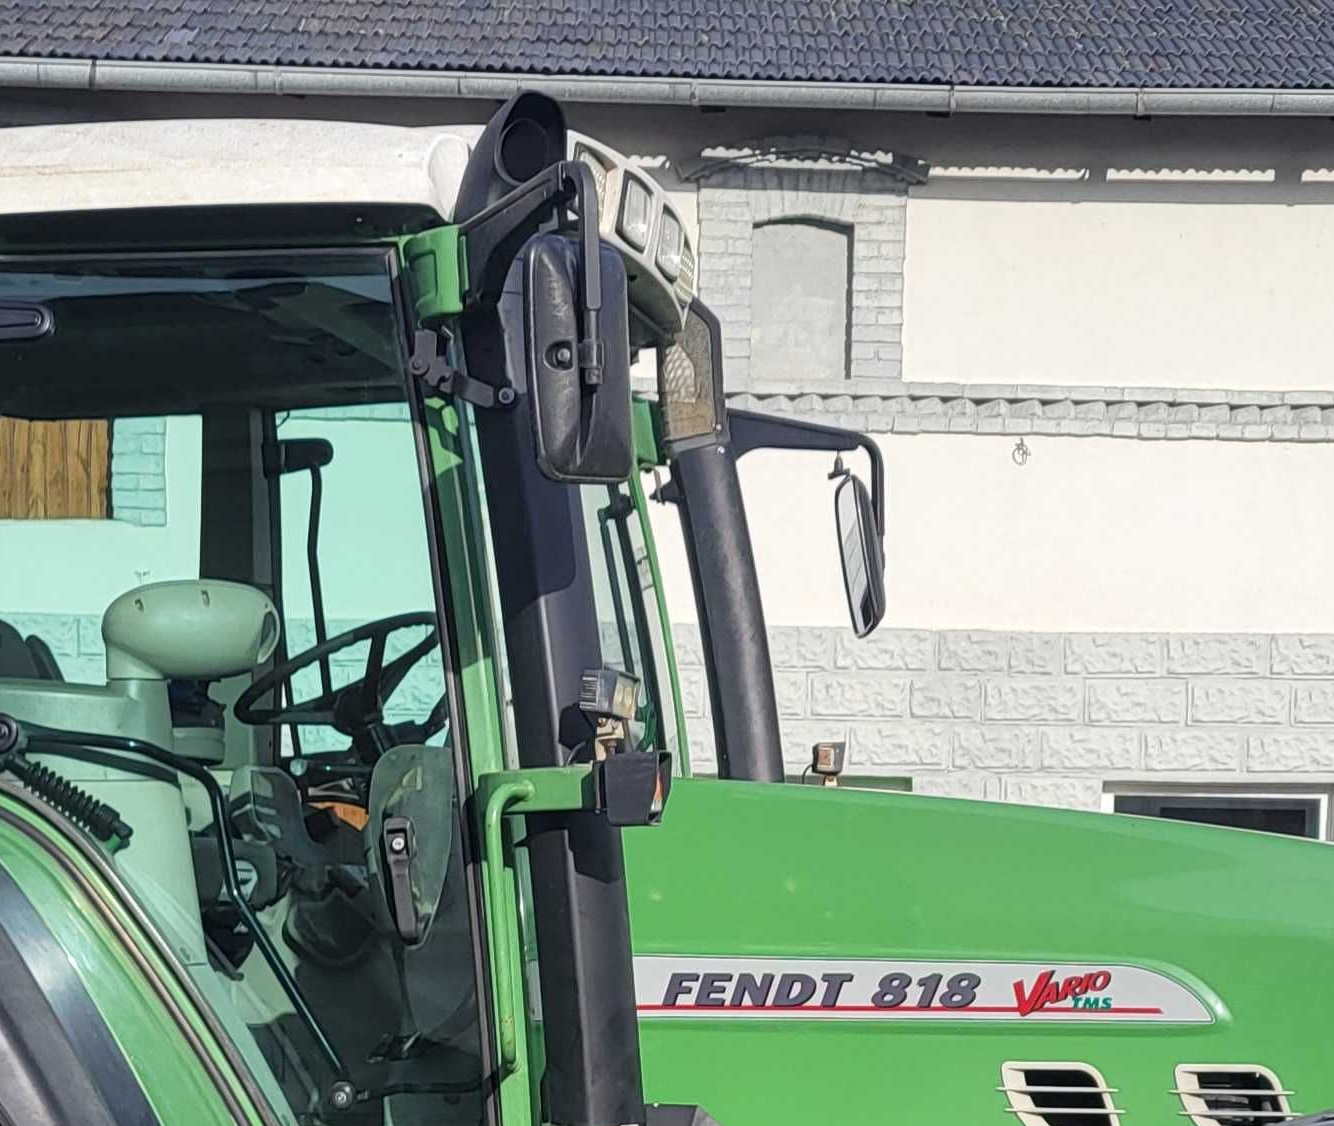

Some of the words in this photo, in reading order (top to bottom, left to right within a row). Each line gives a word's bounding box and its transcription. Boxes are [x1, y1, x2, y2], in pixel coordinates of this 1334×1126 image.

[661, 972, 854, 1007] FENDT
[870, 972, 981, 1008] 818
[1013, 970, 1111, 1017] VARIO
[1072, 996, 1112, 1010] TMS
